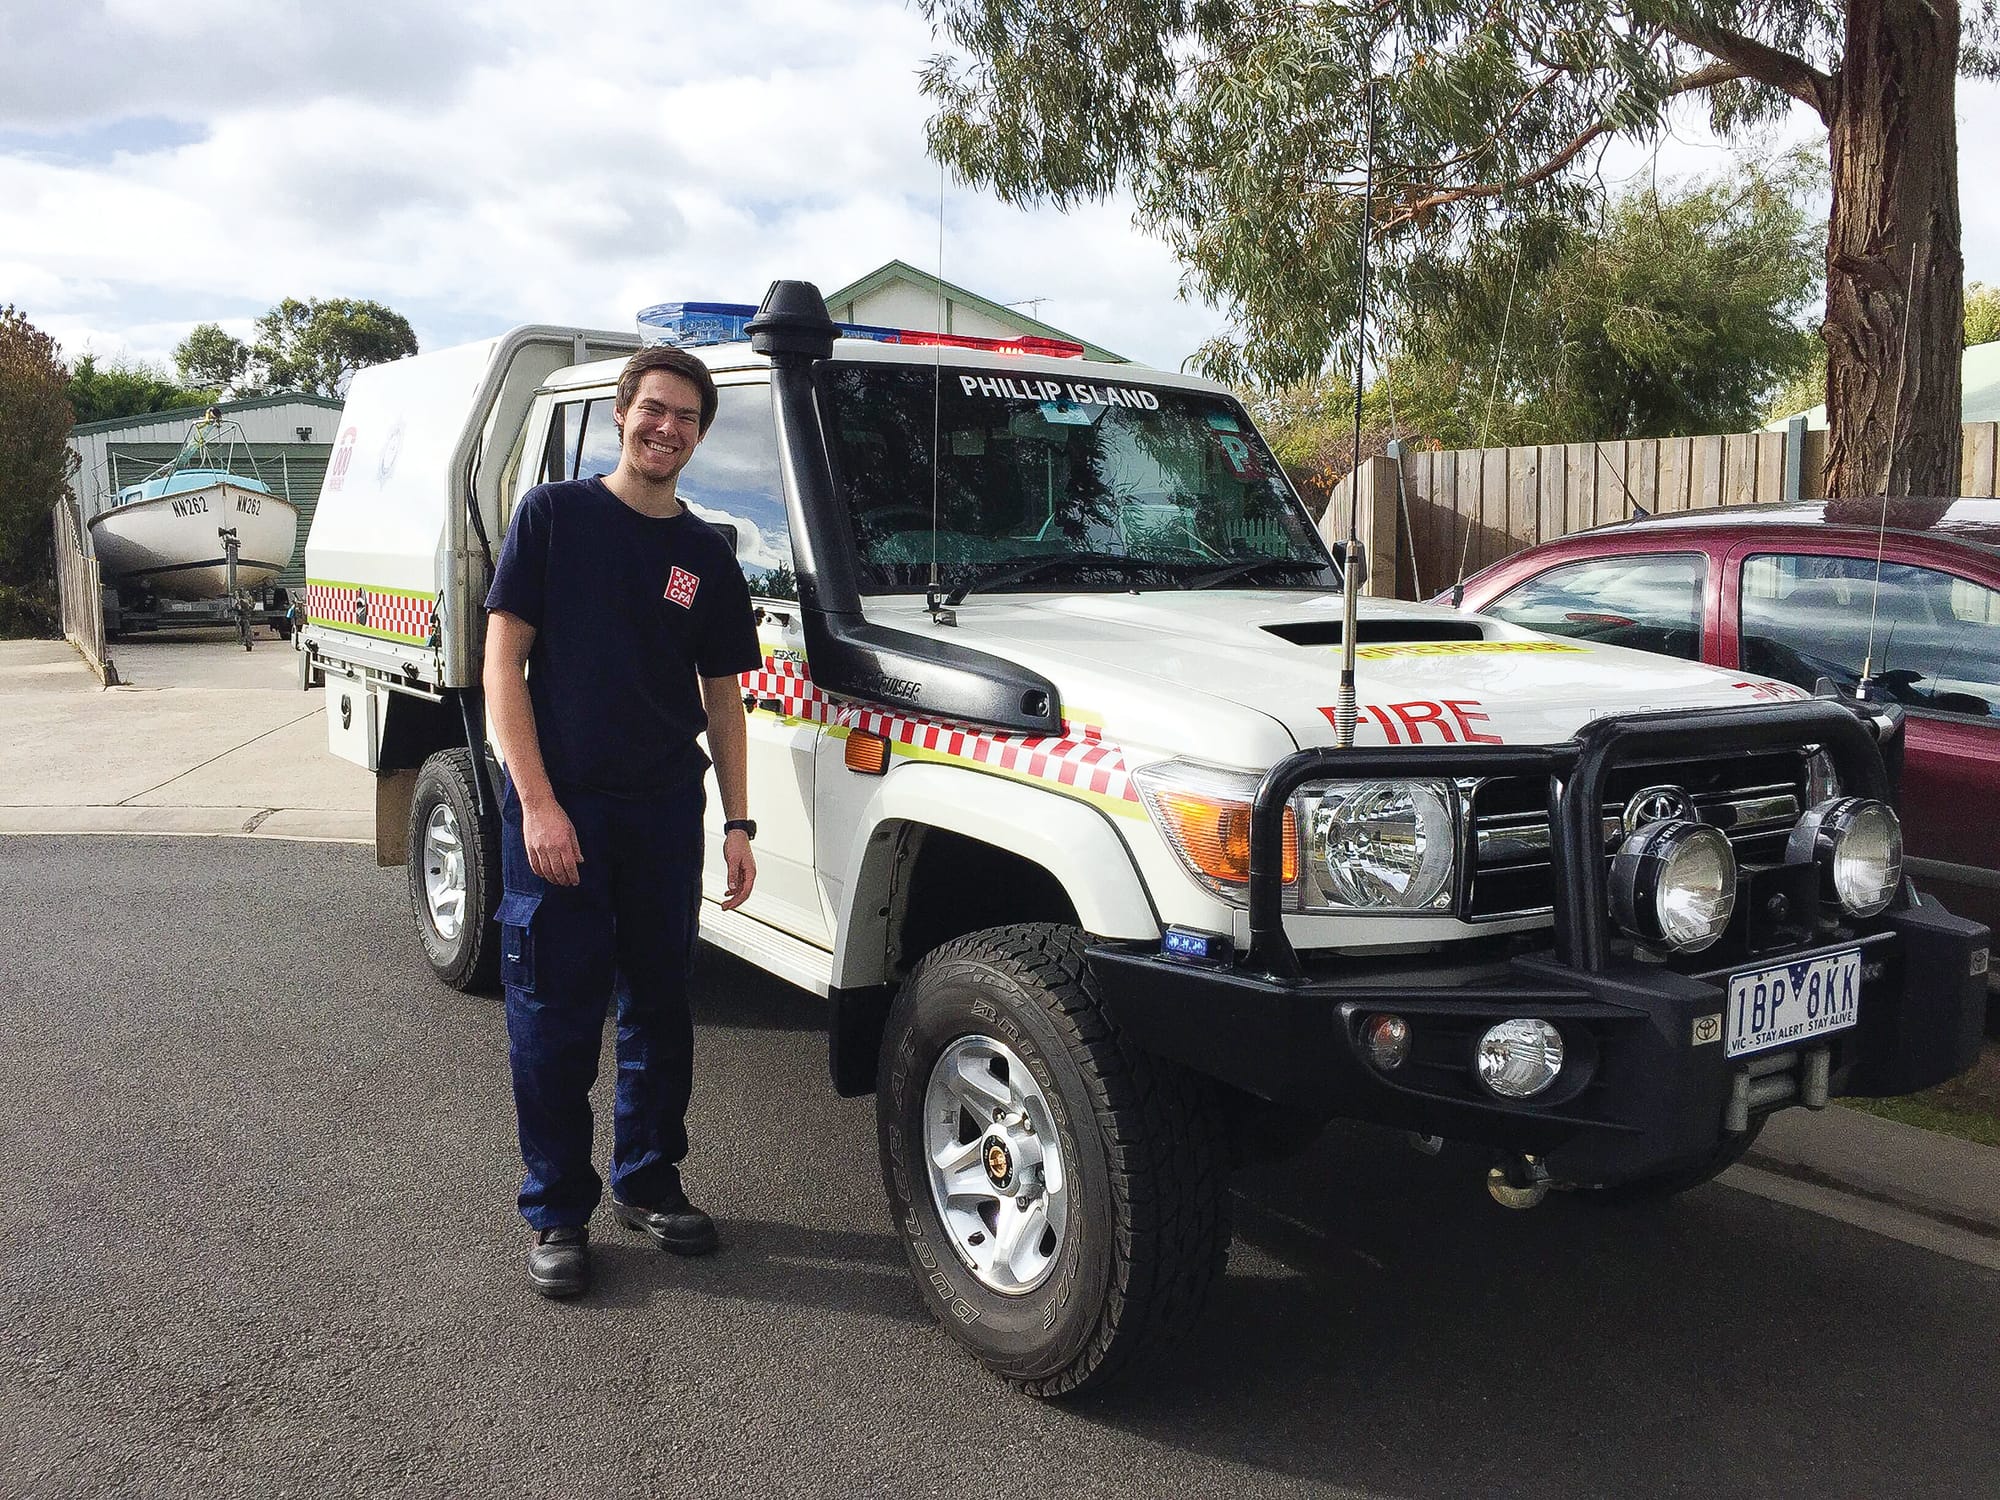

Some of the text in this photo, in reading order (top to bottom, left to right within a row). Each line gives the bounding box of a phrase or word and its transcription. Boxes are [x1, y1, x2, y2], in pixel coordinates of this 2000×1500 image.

[959, 375, 1159, 411] PHILLIP ISLAND
[1220, 434, 1249, 473] P
[171, 495, 209, 518] NN262
[236, 494, 261, 516] NN262
[670, 587, 691, 605] CFA
[1731, 1037, 1746, 1051] VIC
[1755, 1029, 1778, 1045] STAY
[1778, 1022, 1804, 1040] ALERT
[1808, 1016, 1830, 1032] STAY
